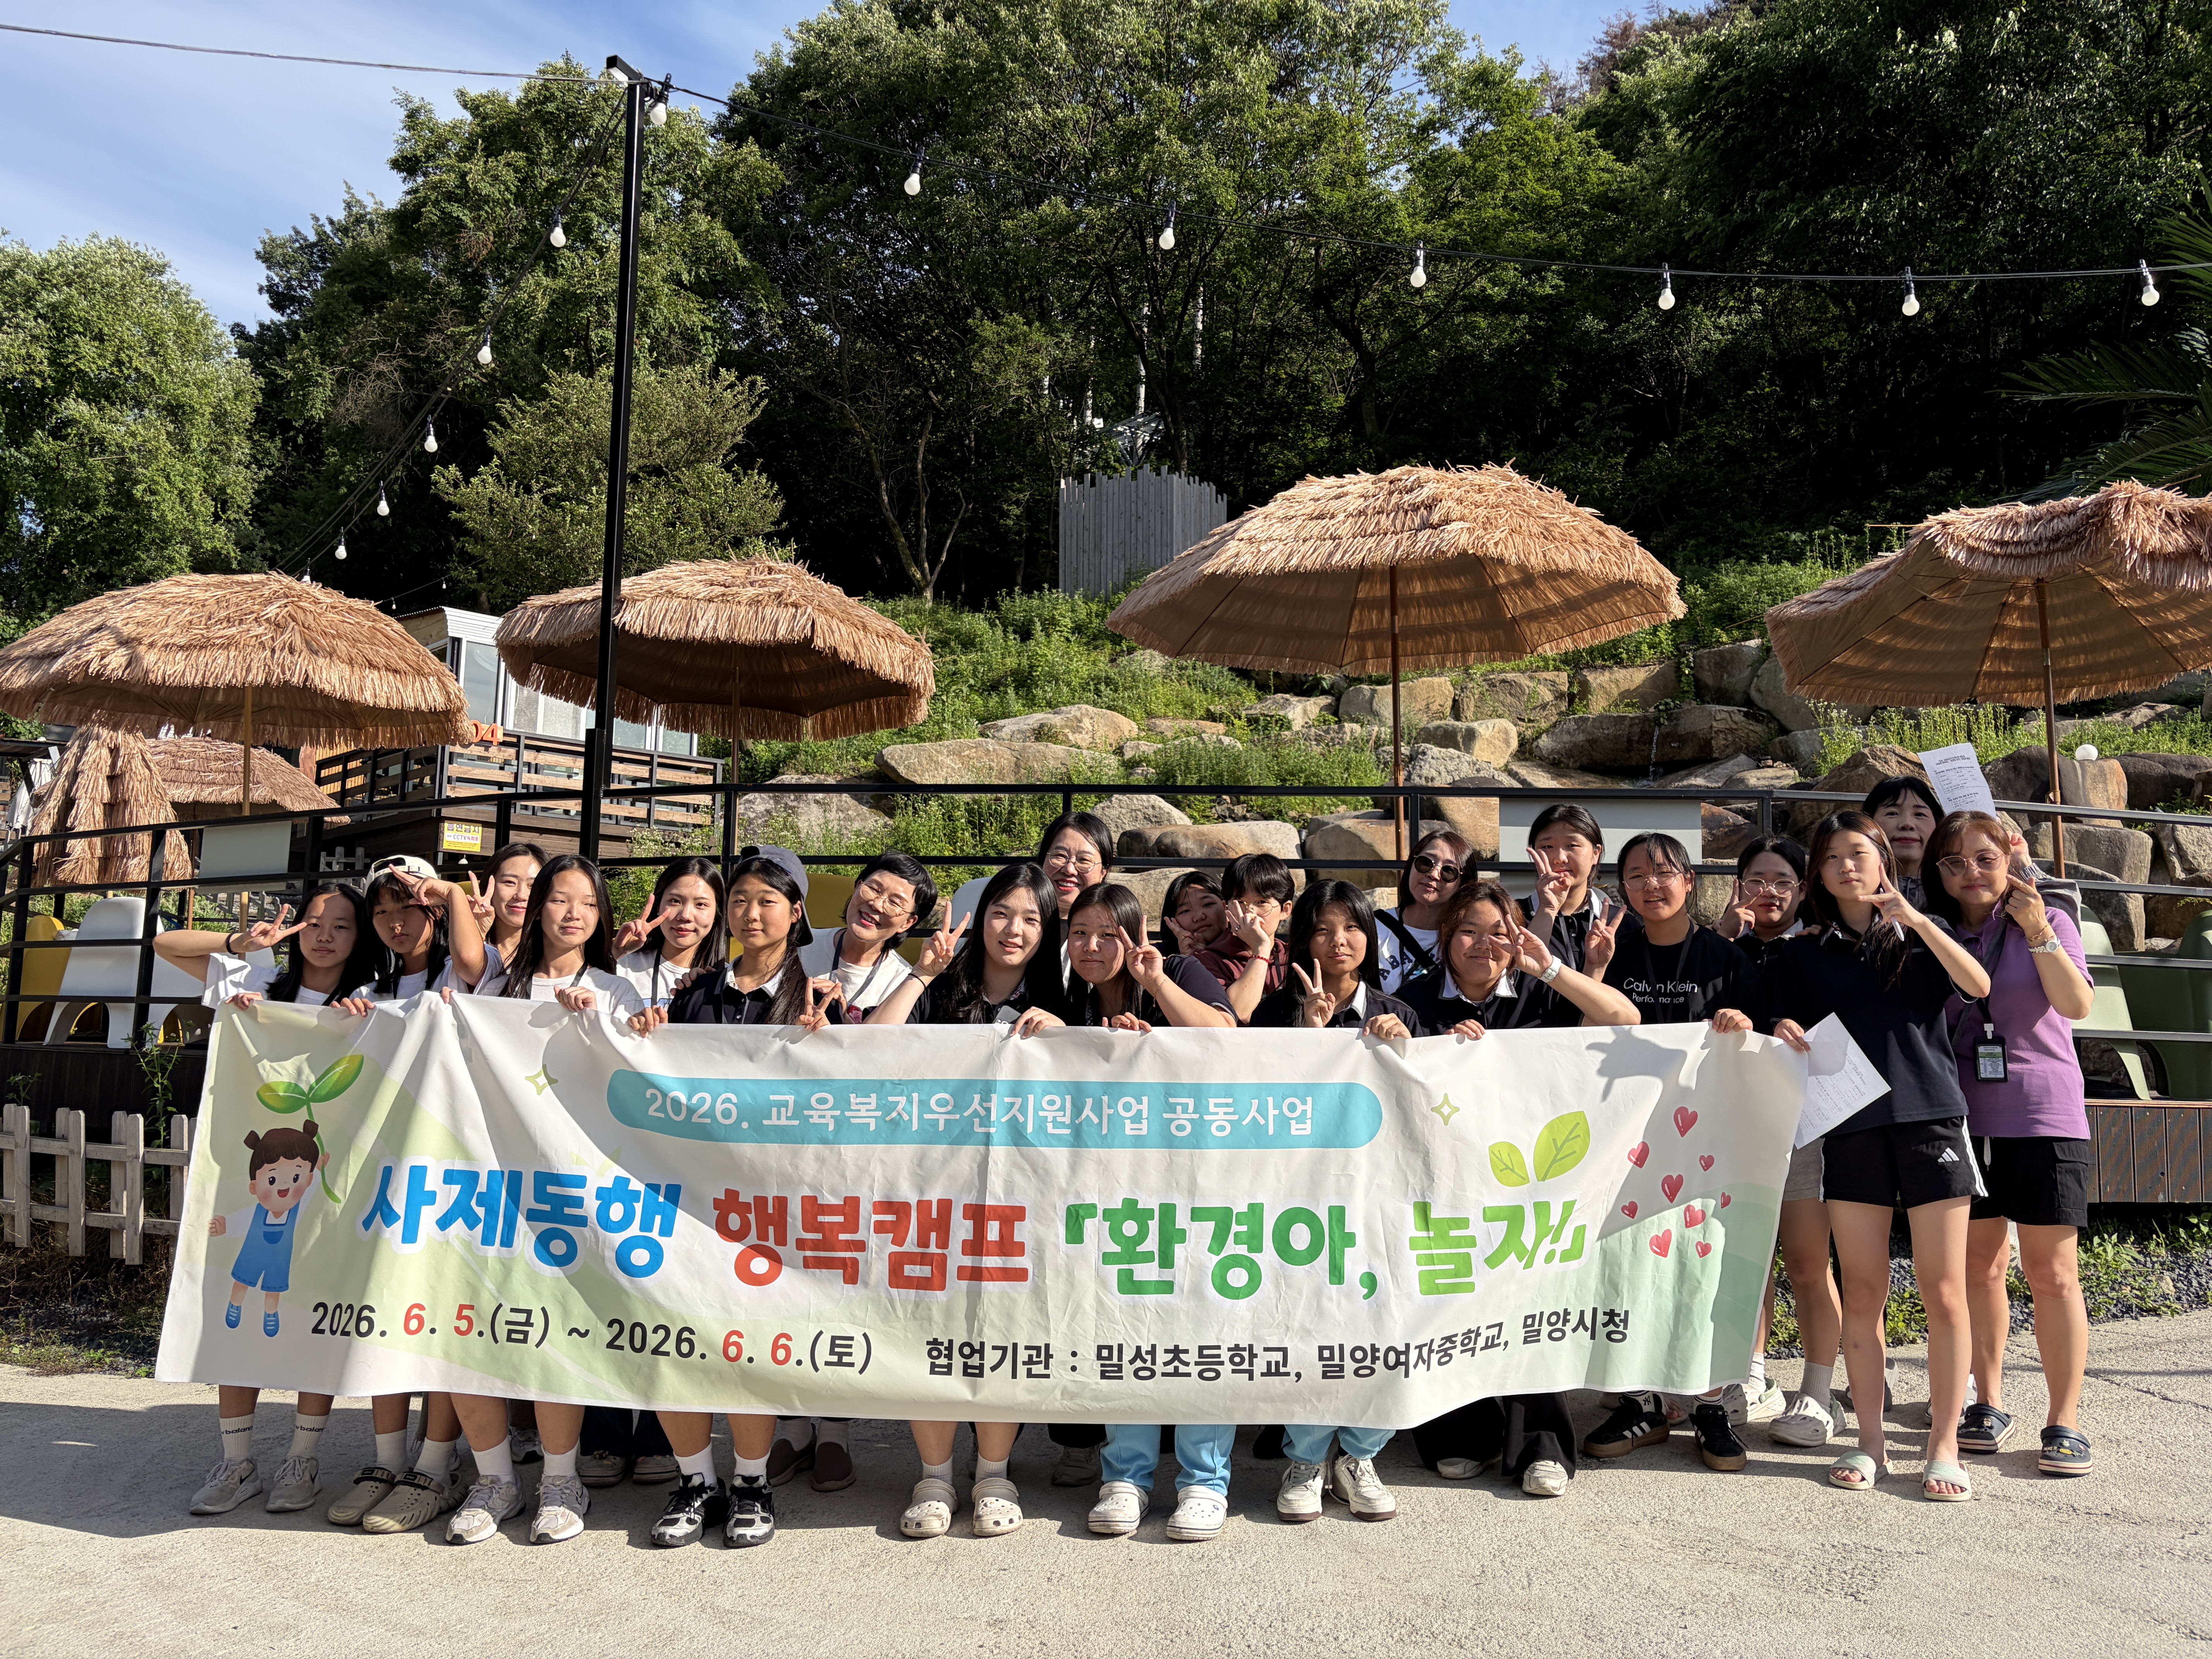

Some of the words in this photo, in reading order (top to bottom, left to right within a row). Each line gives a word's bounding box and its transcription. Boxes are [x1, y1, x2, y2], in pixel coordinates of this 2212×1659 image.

[1623, 977, 1664, 993] Calvn
[1667, 981, 1698, 993] Klein
[1632, 992, 1685, 1003] Perfomace
[646, 1088, 749, 1129] 2026.
[762, 1092, 1149, 1135] 교육복지우선지원사업
[1162, 1096, 1312, 1137] 공동사업
[362, 1165, 682, 1278] 사제동행
[713, 1188, 1029, 1291] 행복캠프
[1065, 1197, 1378, 1301] 「환경아,
[311, 1302, 387, 1338] 2026.
[403, 1303, 437, 1336] 6.
[453, 1302, 550, 1349] 5.(금)
[606, 1318, 707, 1360] 2026.
[722, 1329, 754, 1364] 6.
[771, 1329, 872, 1376] 6.(토)
[926, 1337, 1054, 1379] 협업기관
[1096, 1343, 1302, 1384] 밀성초등학교,
[1317, 1321, 1509, 1379] 밀양여자중학교,
[1522, 1307, 1630, 1346] 밀양시청
[225, 1426, 253, 1434] balanc
